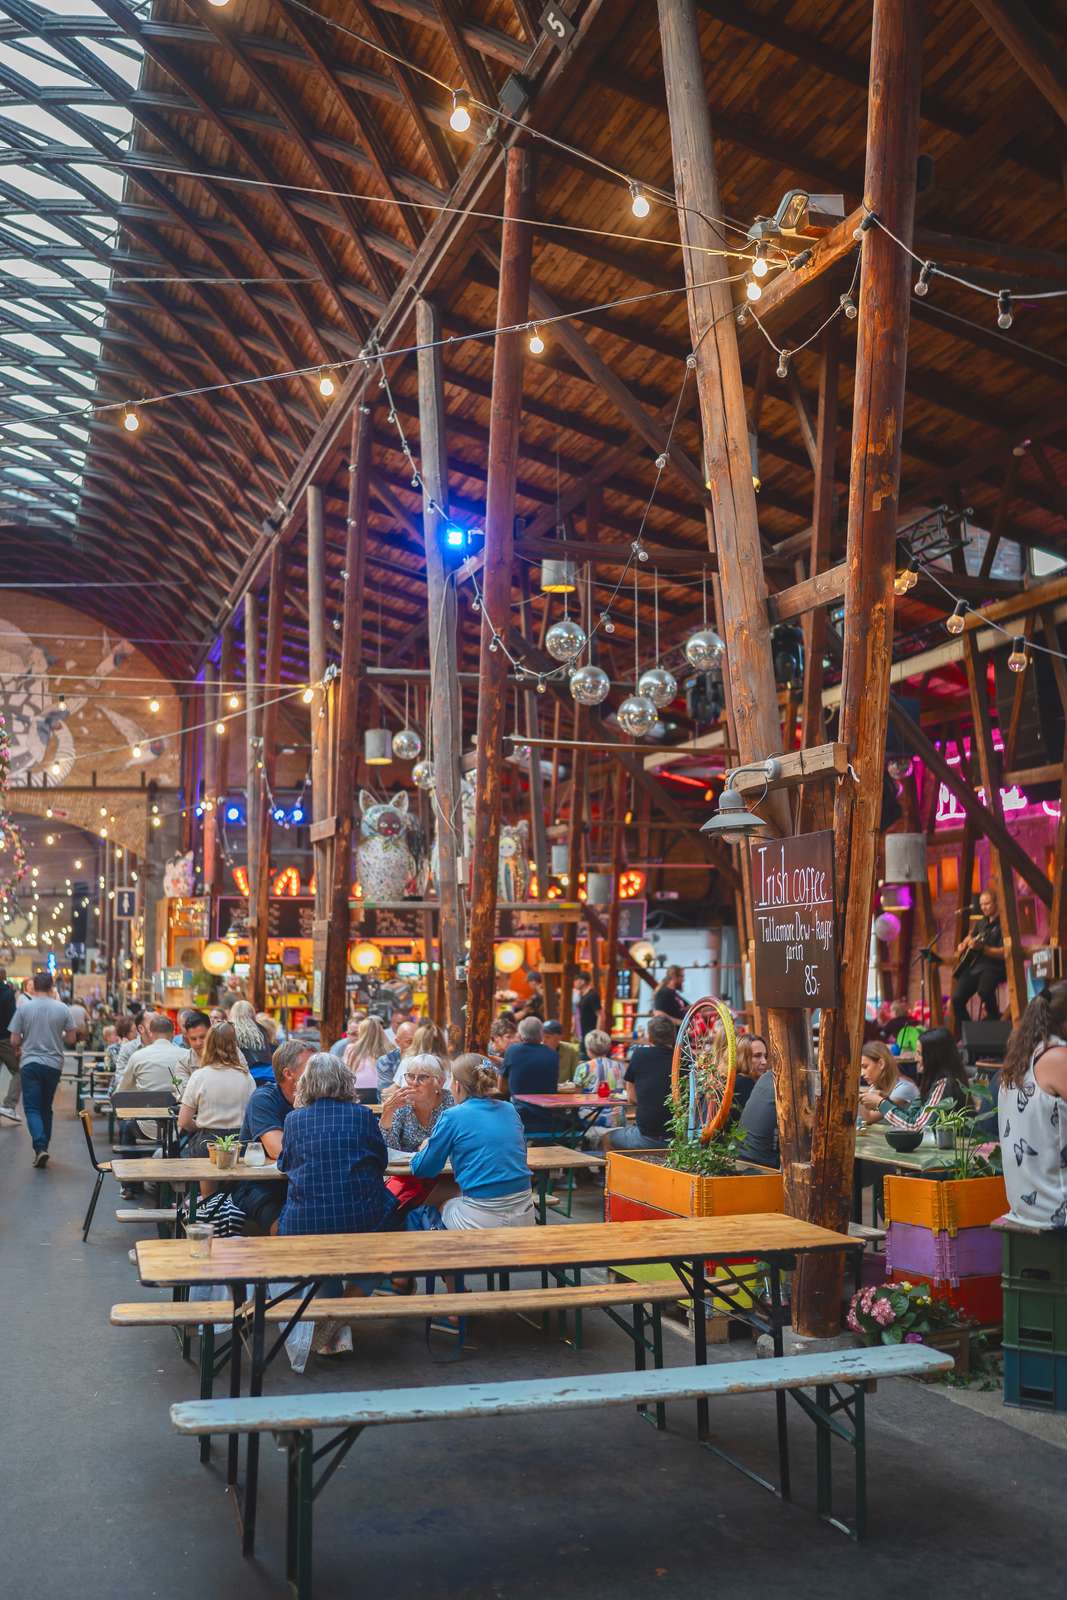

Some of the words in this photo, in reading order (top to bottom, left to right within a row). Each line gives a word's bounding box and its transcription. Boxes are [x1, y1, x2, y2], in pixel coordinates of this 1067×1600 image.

[547, 12, 566, 38] 5
[758, 844, 789, 906] Irish
[792, 866, 827, 912] coffee
[757, 915, 795, 943] Tullamore
[795, 911, 810, 942] Dew
